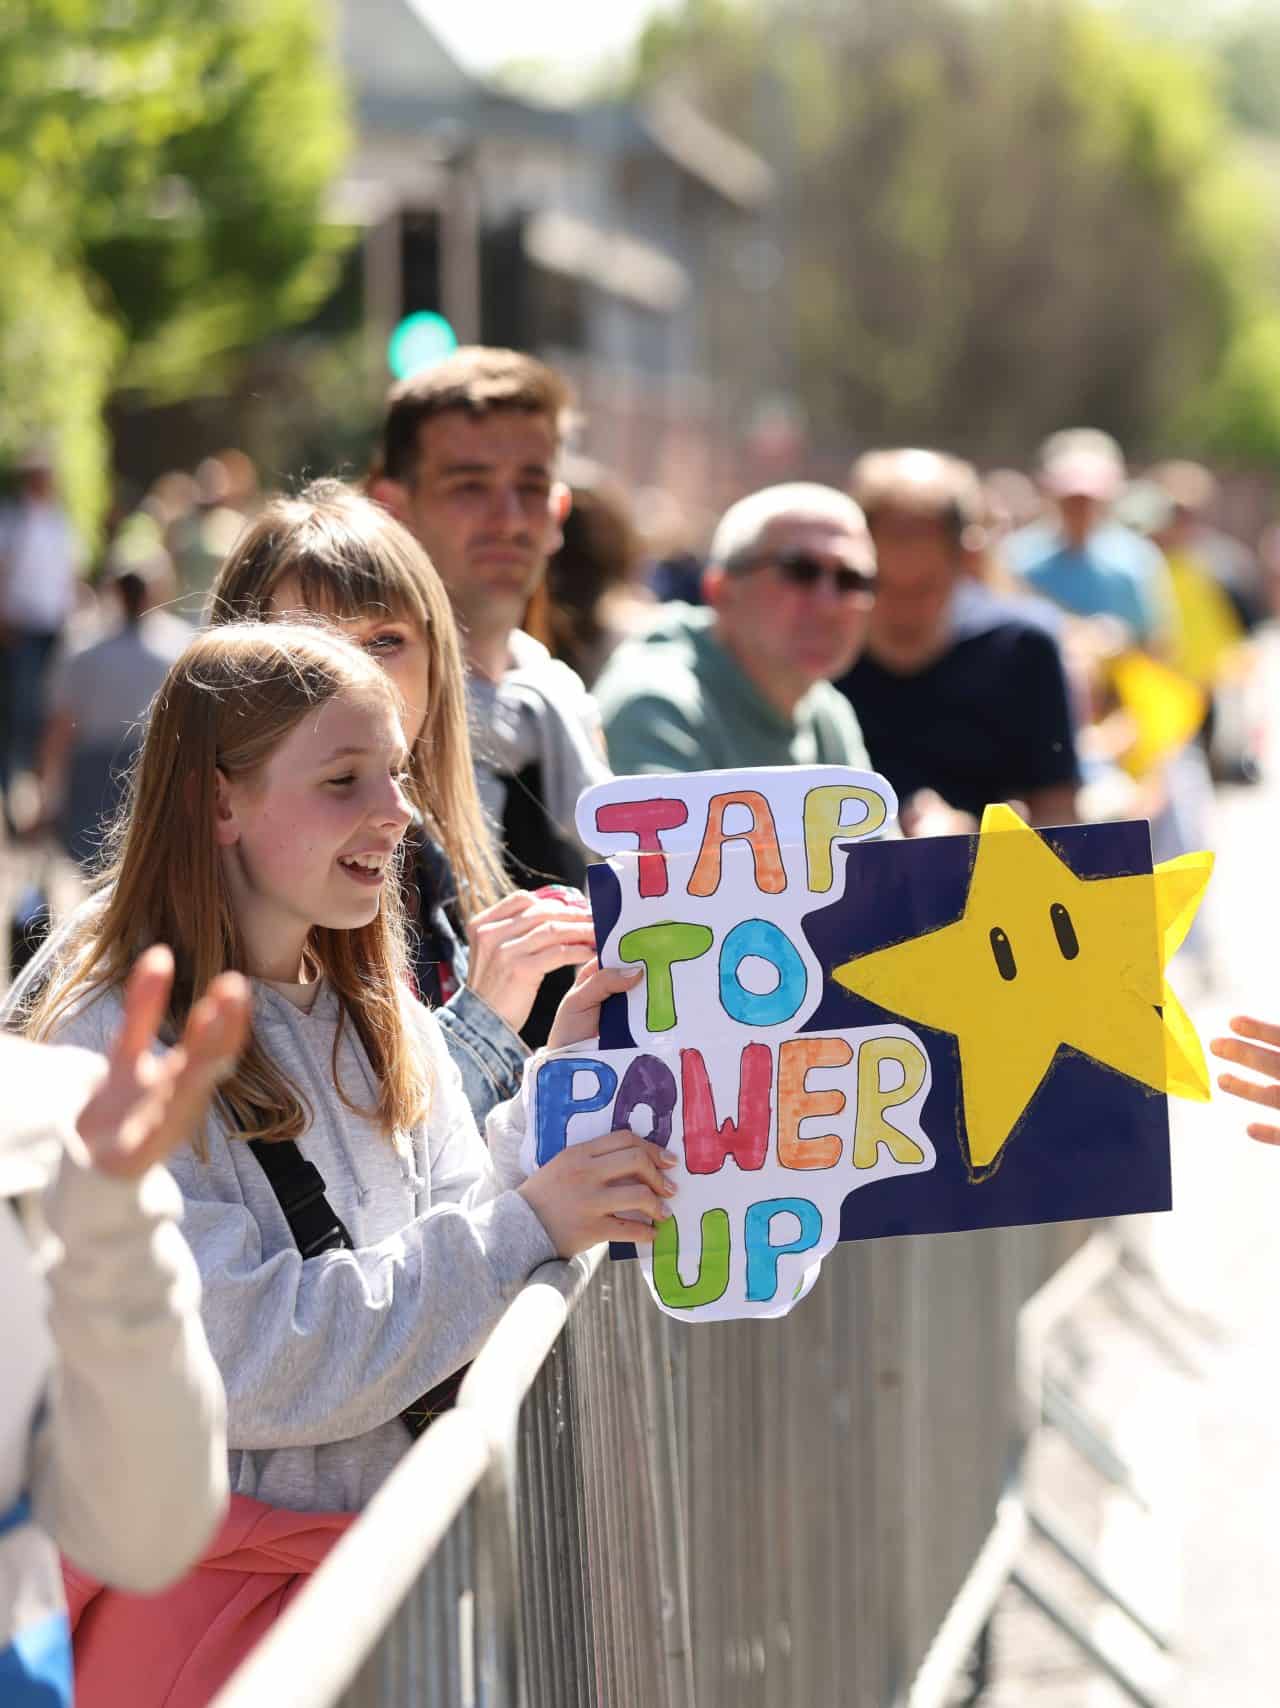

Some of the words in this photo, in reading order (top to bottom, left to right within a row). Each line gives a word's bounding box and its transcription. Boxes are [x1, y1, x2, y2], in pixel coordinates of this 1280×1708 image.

[595, 784, 887, 898] TAP
[618, 918, 808, 1032] TO
[535, 1036, 926, 1175] POWER
[652, 1195, 823, 1309] UP
